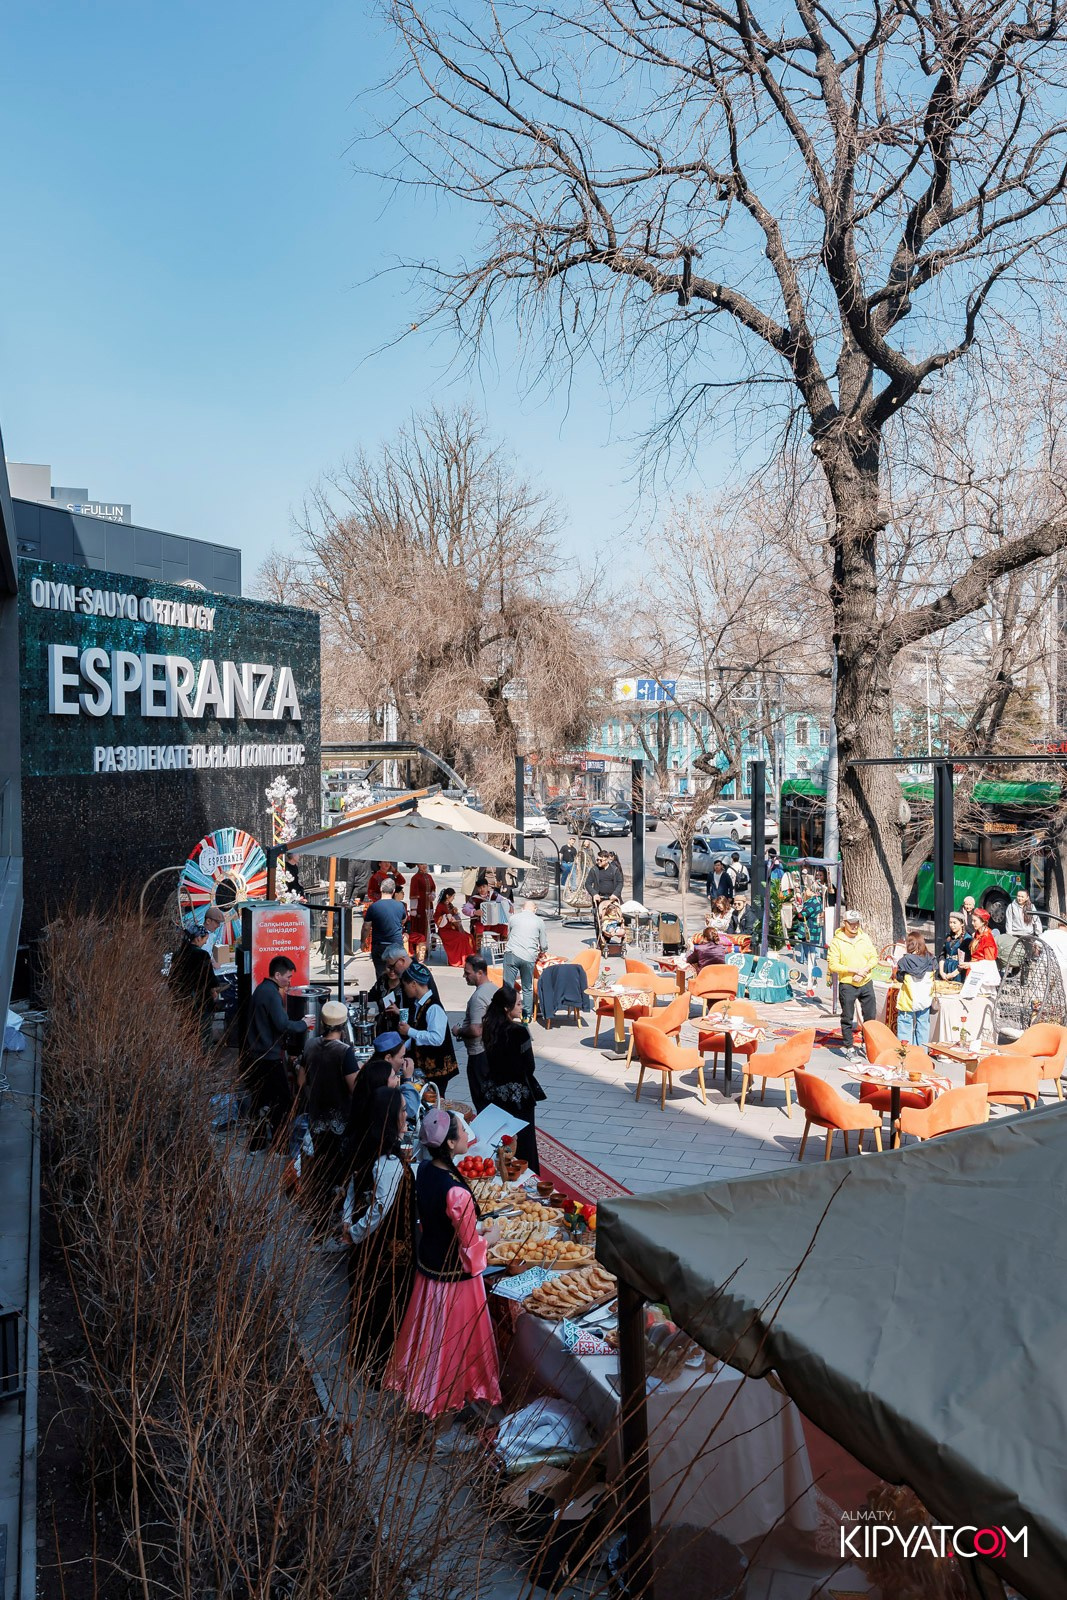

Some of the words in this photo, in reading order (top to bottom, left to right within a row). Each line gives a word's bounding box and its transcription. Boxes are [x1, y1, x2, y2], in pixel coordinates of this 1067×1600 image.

[31, 578, 138, 620] OIYN-SAUYQ
[48, 643, 302, 720] ESPERANZA
[241, 743, 306, 767] КОМПЛЕКС
[208, 853, 243, 866] ESPERANZA
